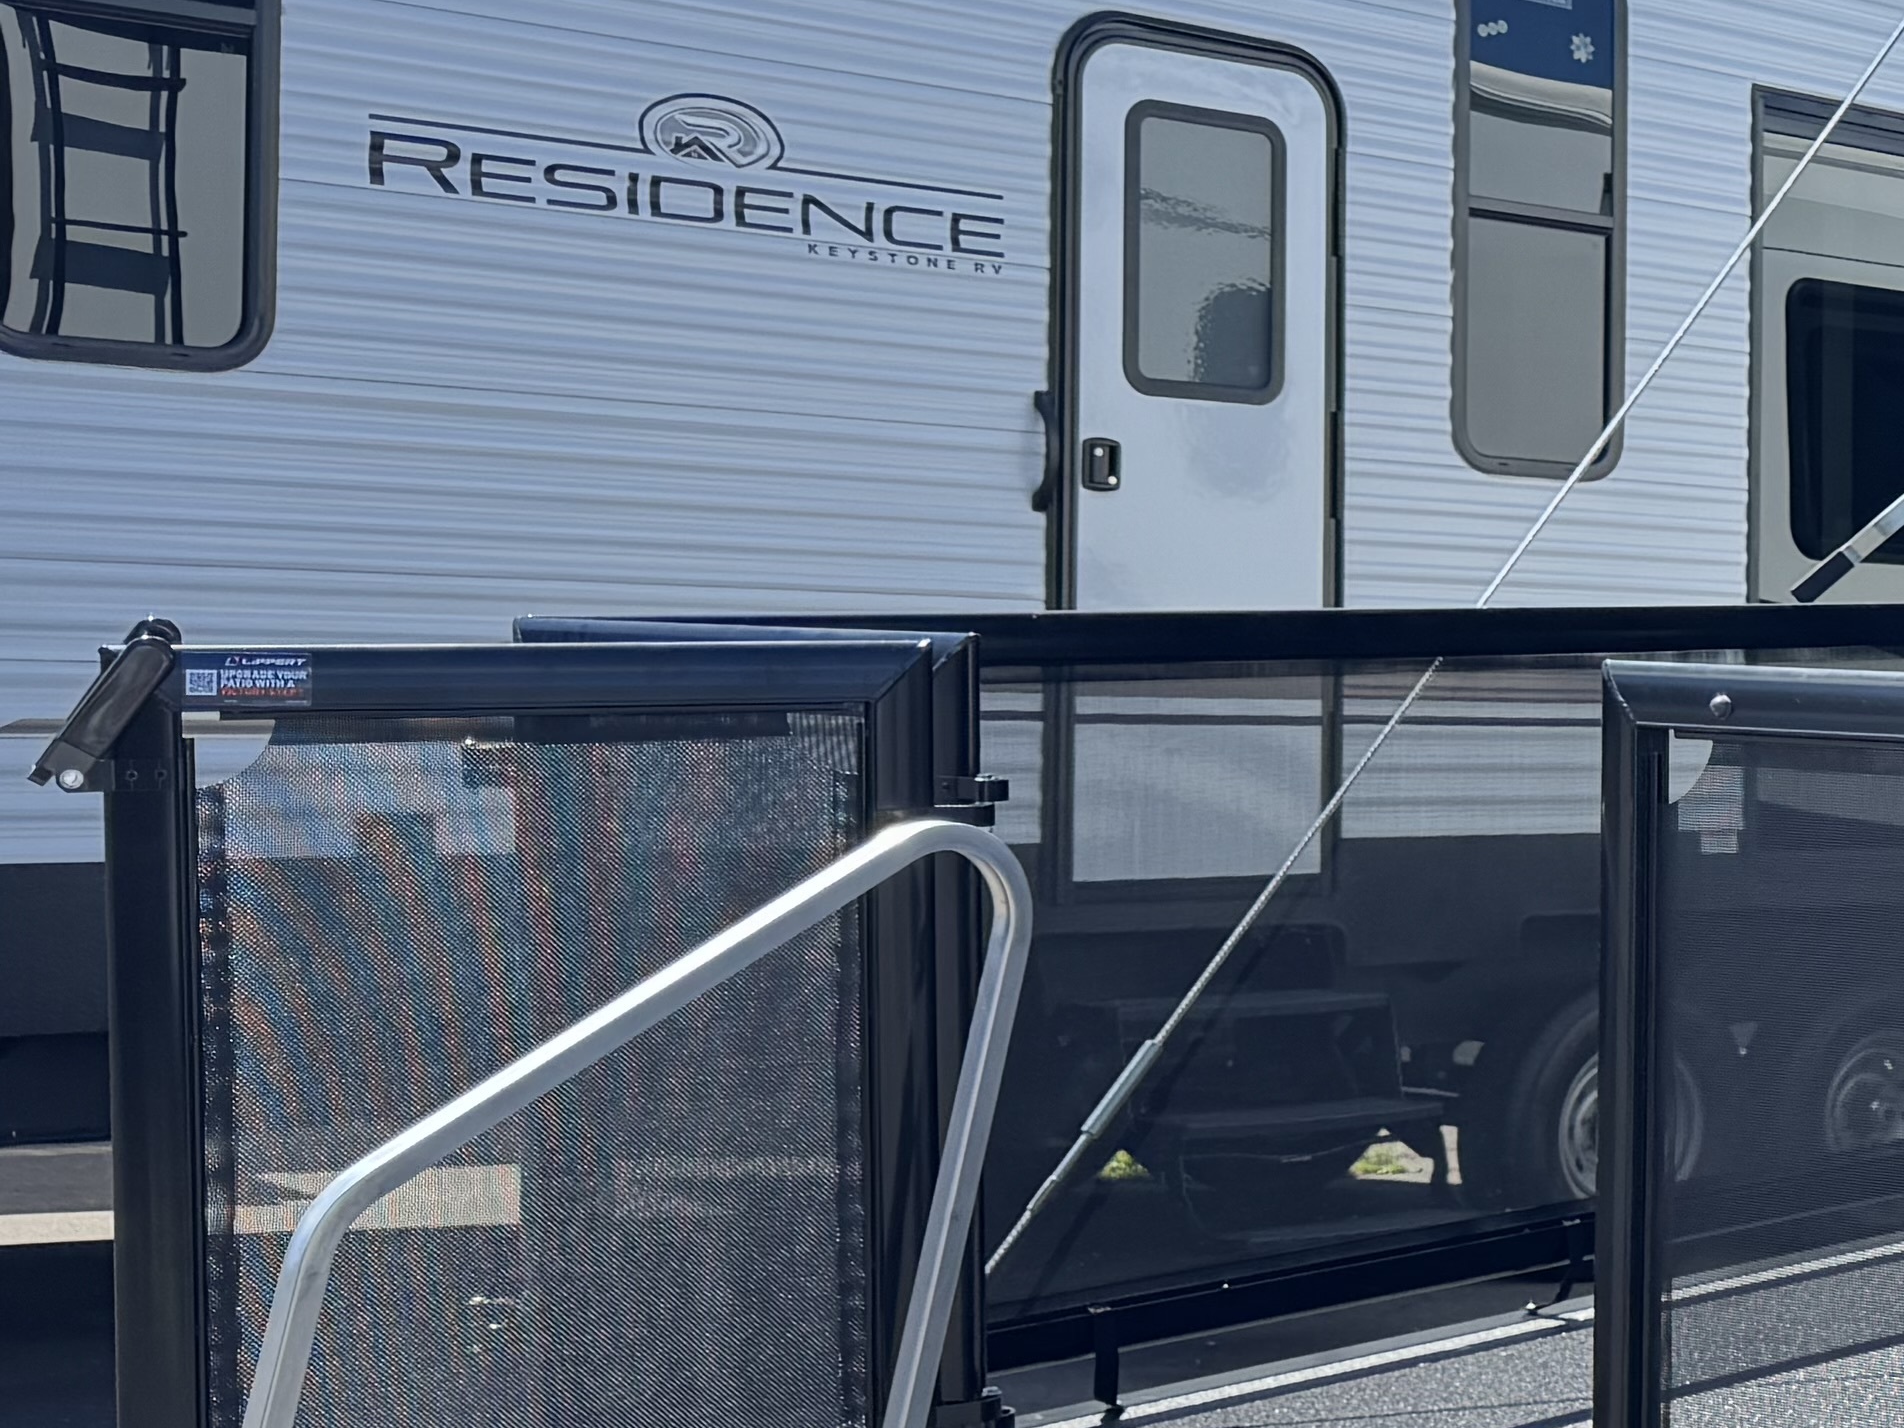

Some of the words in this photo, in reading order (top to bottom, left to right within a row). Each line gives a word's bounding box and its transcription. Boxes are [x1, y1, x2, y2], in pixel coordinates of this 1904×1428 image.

[368, 130, 1005, 259] RESIDENCE
[807, 243, 956, 270] KEYSTONE
[974, 262, 1003, 276] RV
[220, 669, 276, 679] UPGRADE
[220, 679, 251, 688] PATIO
[255, 679, 284, 688] WITH
